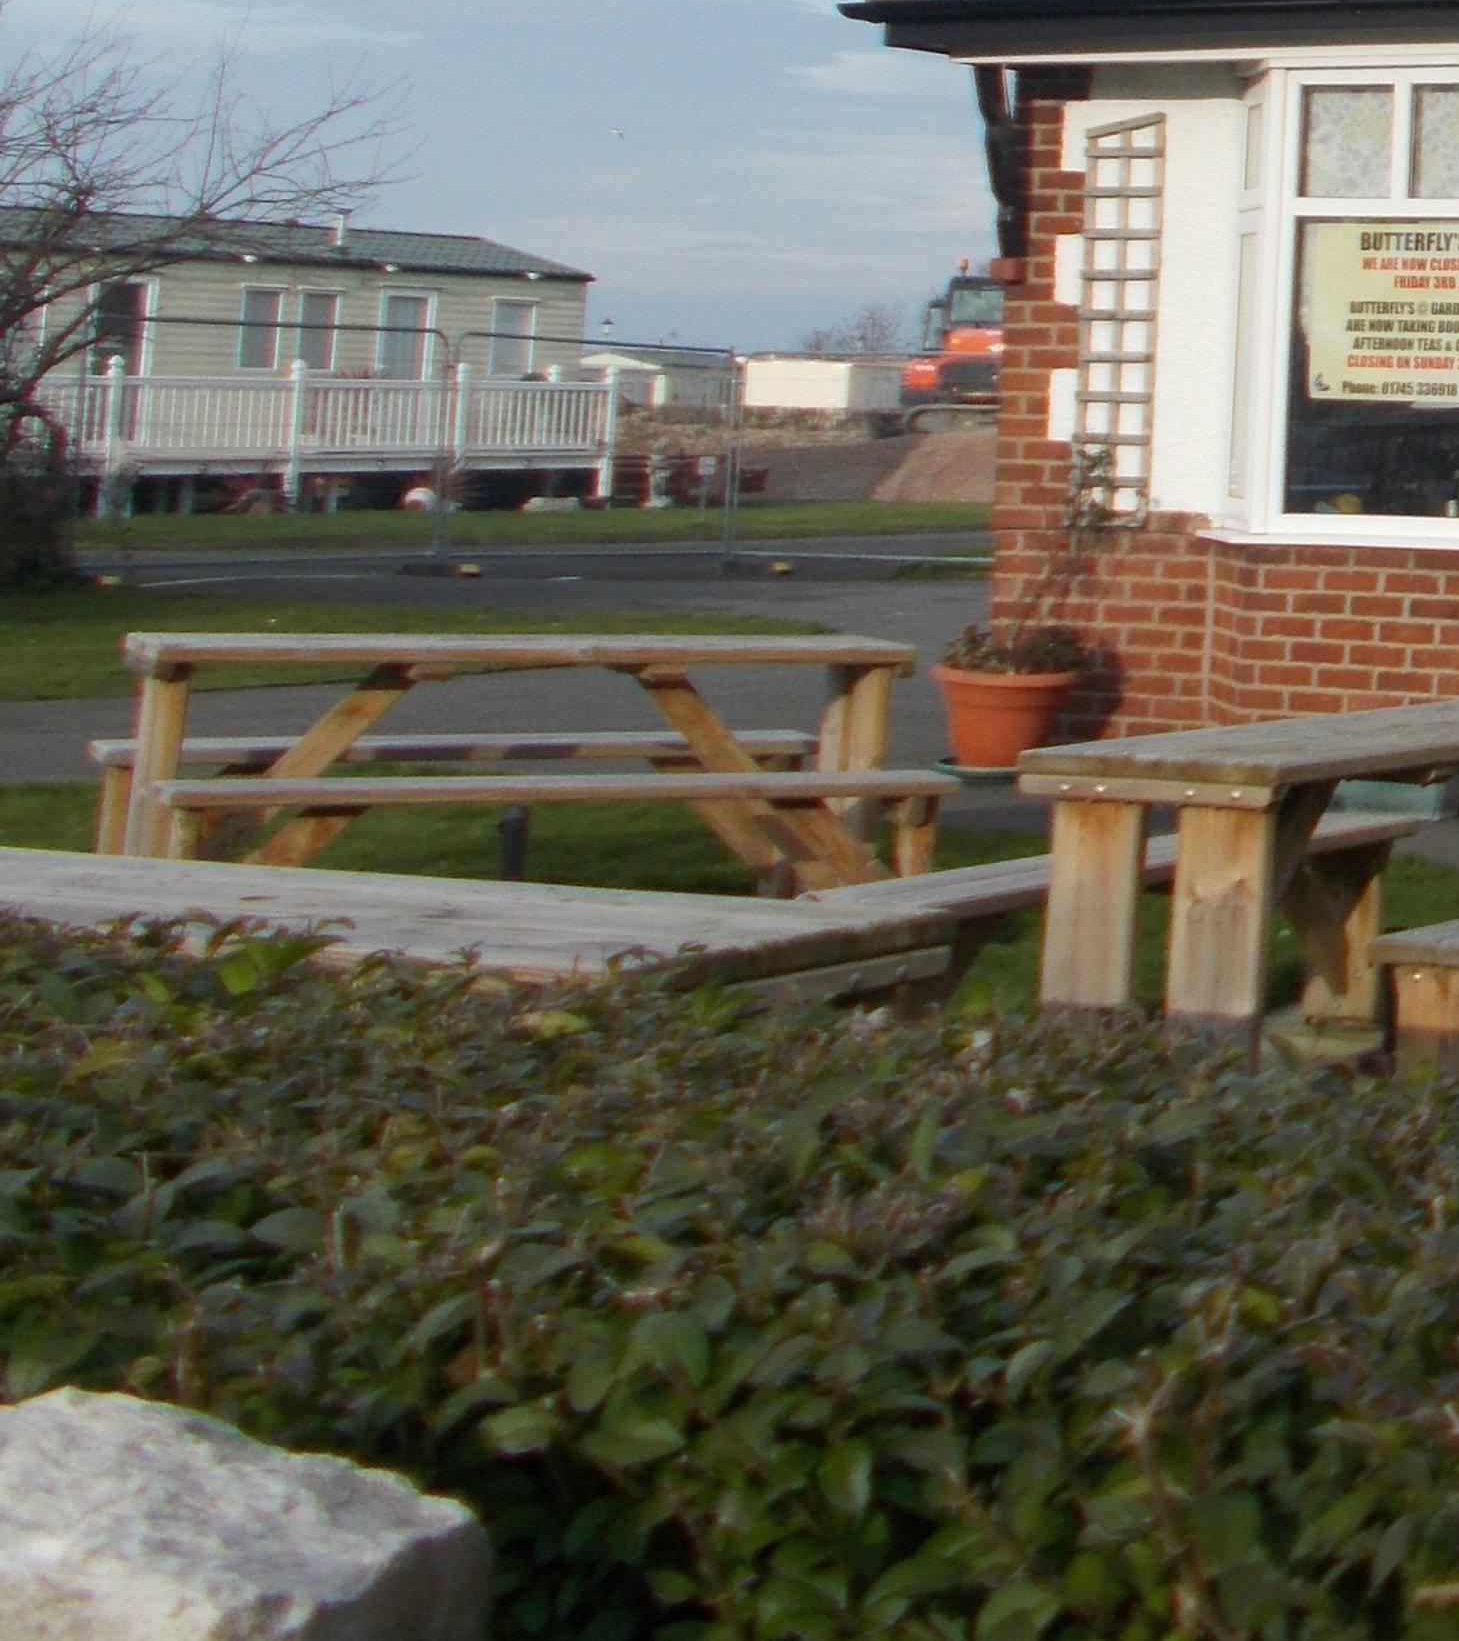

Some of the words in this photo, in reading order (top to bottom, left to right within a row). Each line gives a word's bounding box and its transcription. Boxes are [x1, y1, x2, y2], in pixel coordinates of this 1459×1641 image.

[1362, 257, 1377, 270] WE
[1379, 257, 1399, 271] ARE
[1401, 258, 1428, 271] NOW
[1394, 275, 1431, 289] FRIDAY
[1433, 276, 1456, 289] 3RD
[1350, 301, 1415, 315] BUTTERFLY'S
[1345, 319, 1366, 332] ARE
[1369, 319, 1394, 332] NOW
[1398, 320, 1435, 333] TAKING
[1353, 337, 1414, 350] AFTERNOON
[1417, 337, 1442, 351] TEAS
[1347, 355, 1393, 368] CLOSING
[1396, 355, 1410, 369] ON
[1413, 356, 1454, 369] SUNDAY
[1342, 381, 1379, 394] Phone:
[1381, 382, 1414, 395] 01745
